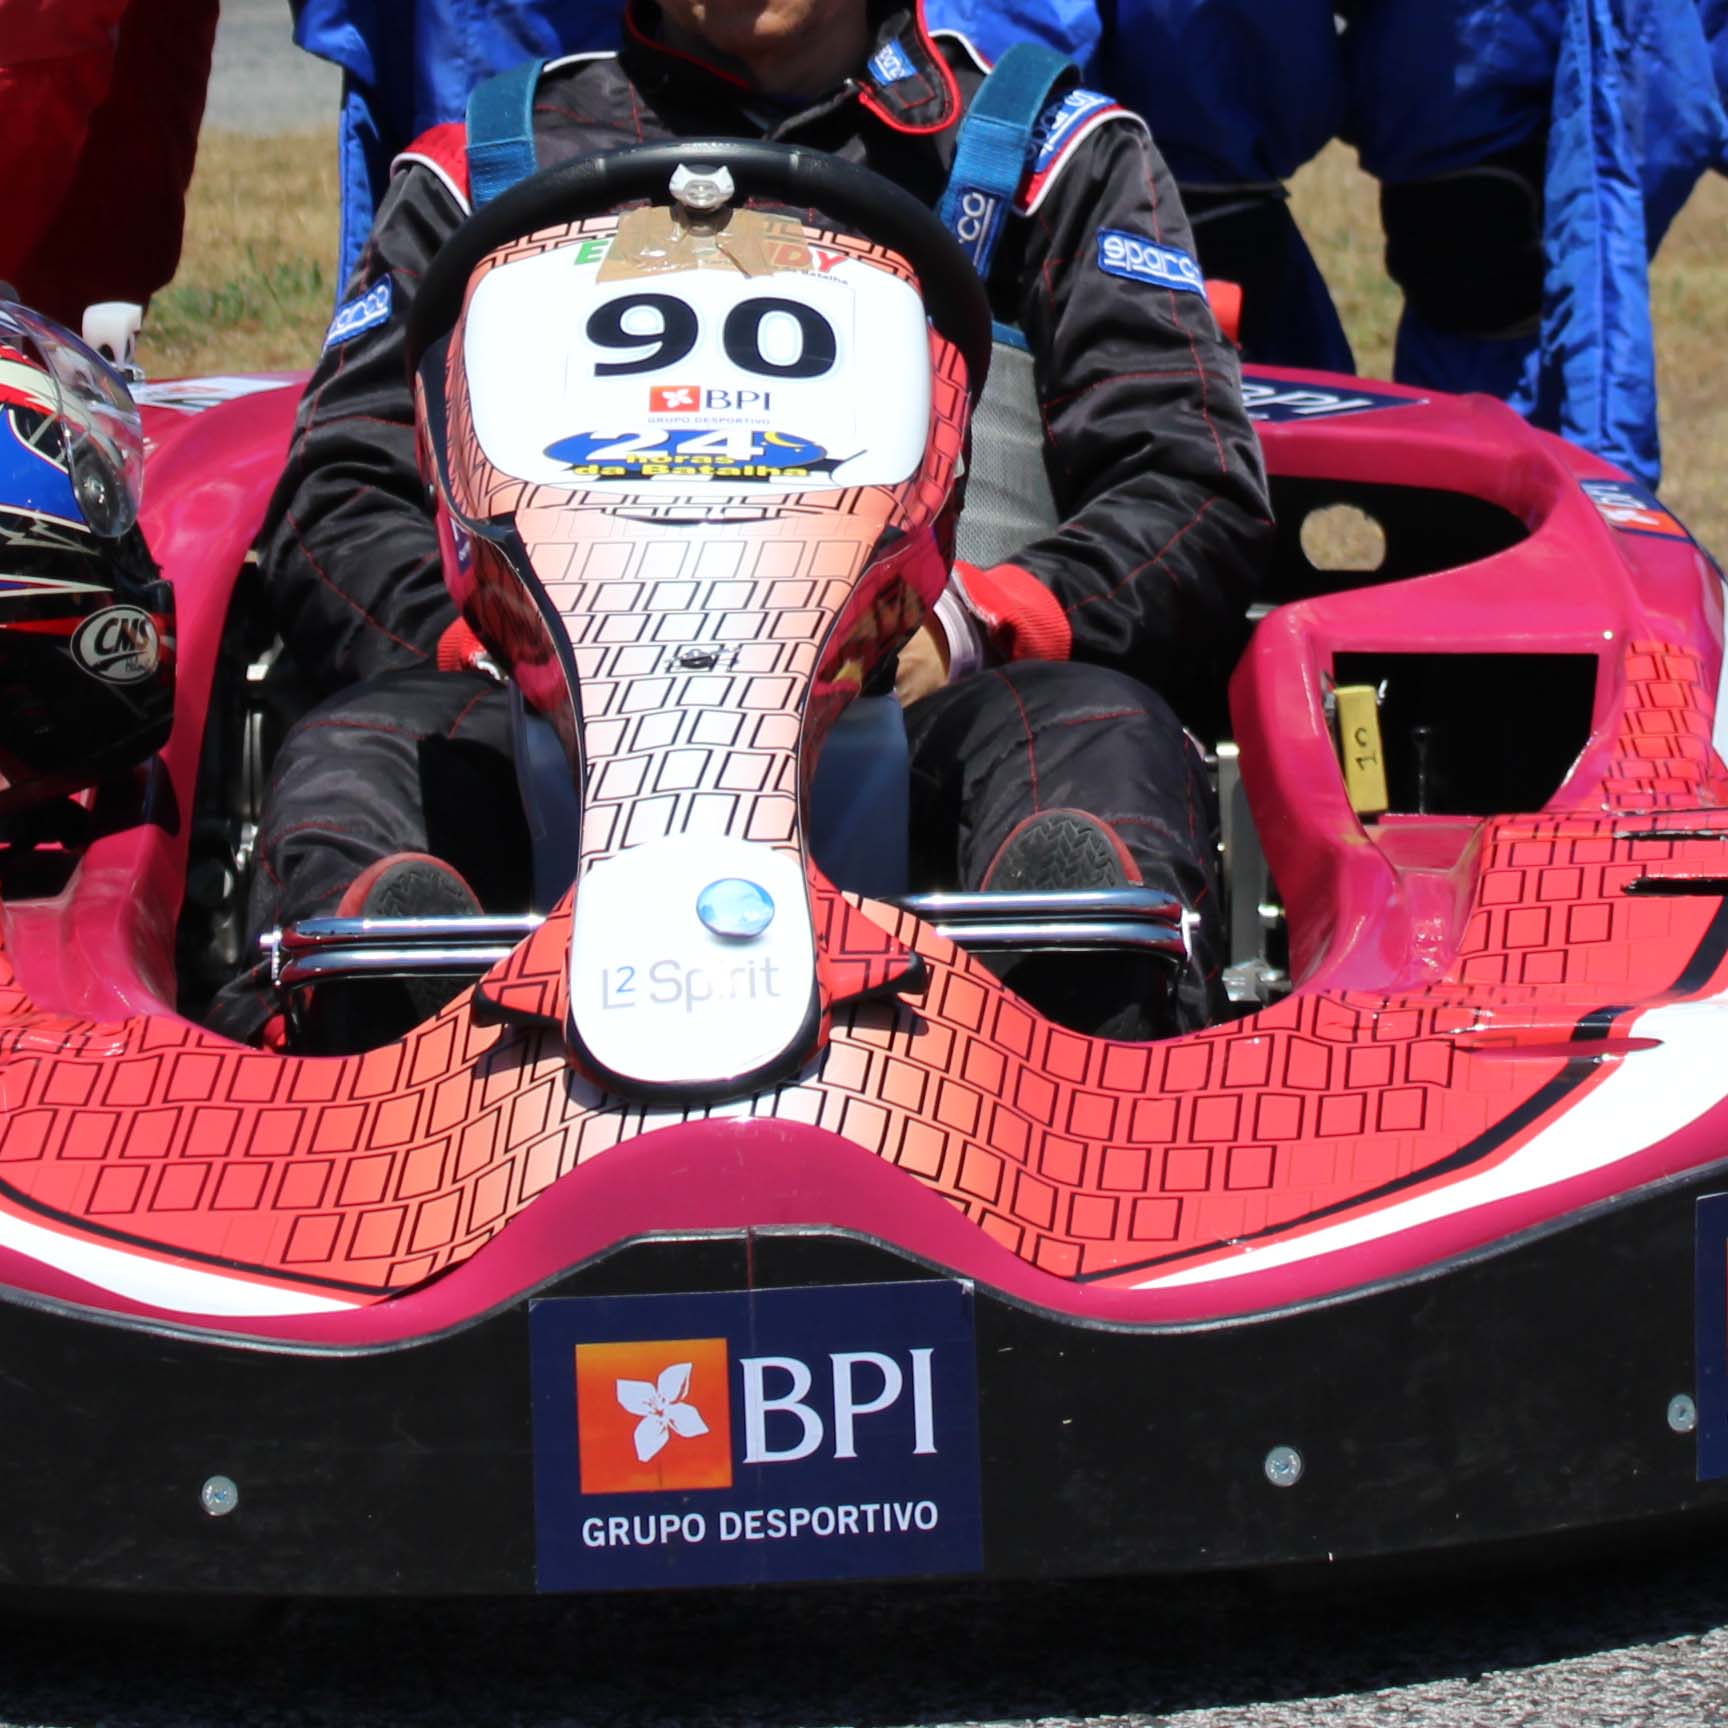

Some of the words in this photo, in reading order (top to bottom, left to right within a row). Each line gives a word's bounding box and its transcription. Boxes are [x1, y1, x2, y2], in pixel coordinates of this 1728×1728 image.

[586, 293, 837, 379] 90
[705, 389, 771, 411] BPI
[647, 416, 690, 424] GRUPO
[695, 416, 771, 425] DESPORTIVO
[585, 428, 765, 462] 24
[626, 454, 735, 465] horas
[573, 464, 627, 477] da
[641, 463, 810, 478] Batalha
[94, 616, 150, 657] CMS
[649, 957, 781, 1013] Sprit
[739, 1348, 938, 1464] BPI
[582, 1513, 706, 1547] GRUPO
[720, 1501, 938, 1541] DESPORTIVO
